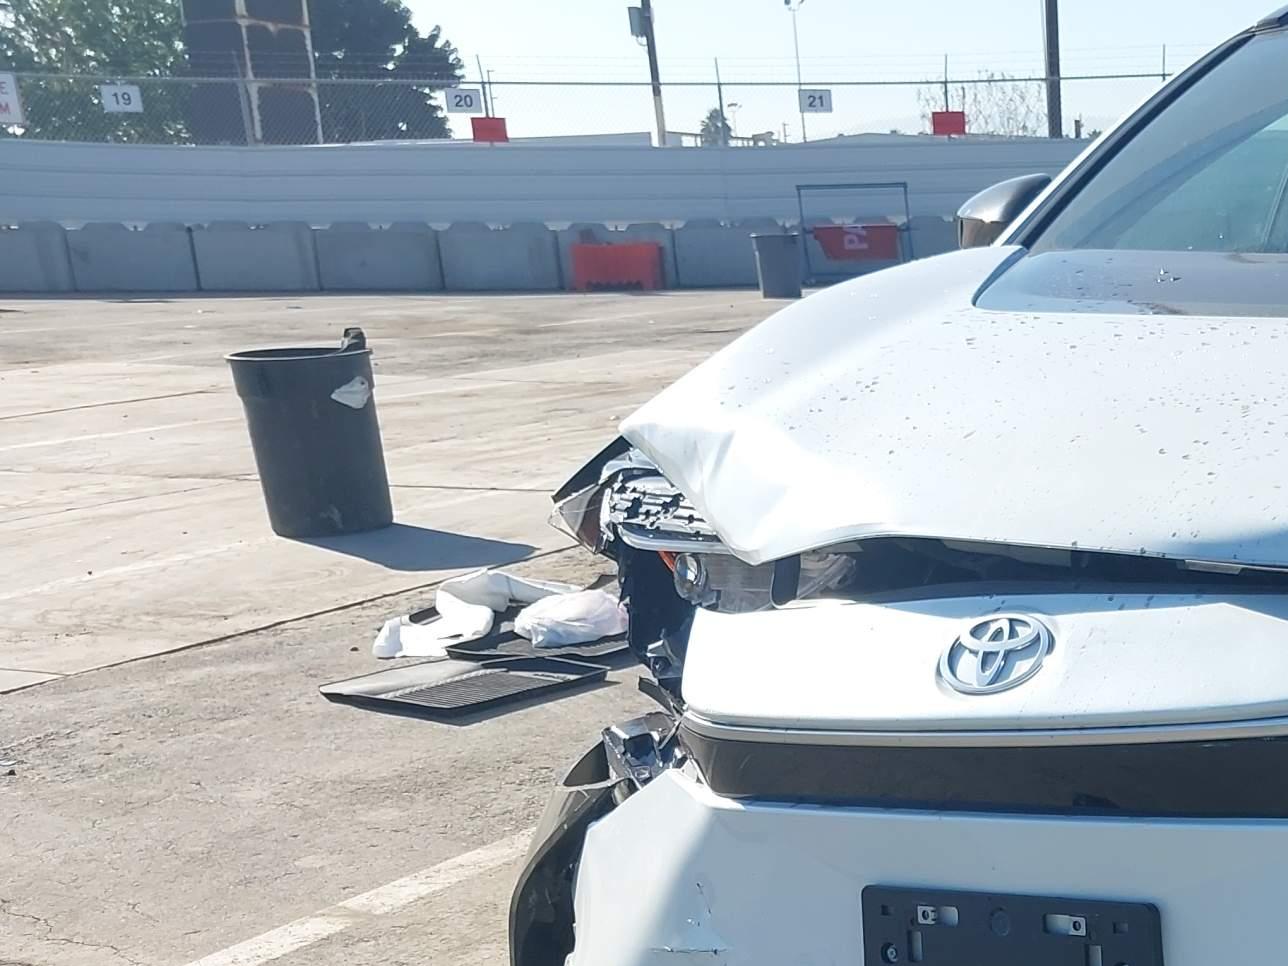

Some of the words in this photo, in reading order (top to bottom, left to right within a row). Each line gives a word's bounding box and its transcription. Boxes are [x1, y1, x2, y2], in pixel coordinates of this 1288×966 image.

[111, 91, 133, 106] 19
[453, 94, 474, 108] 20
[807, 95, 825, 108] 21
